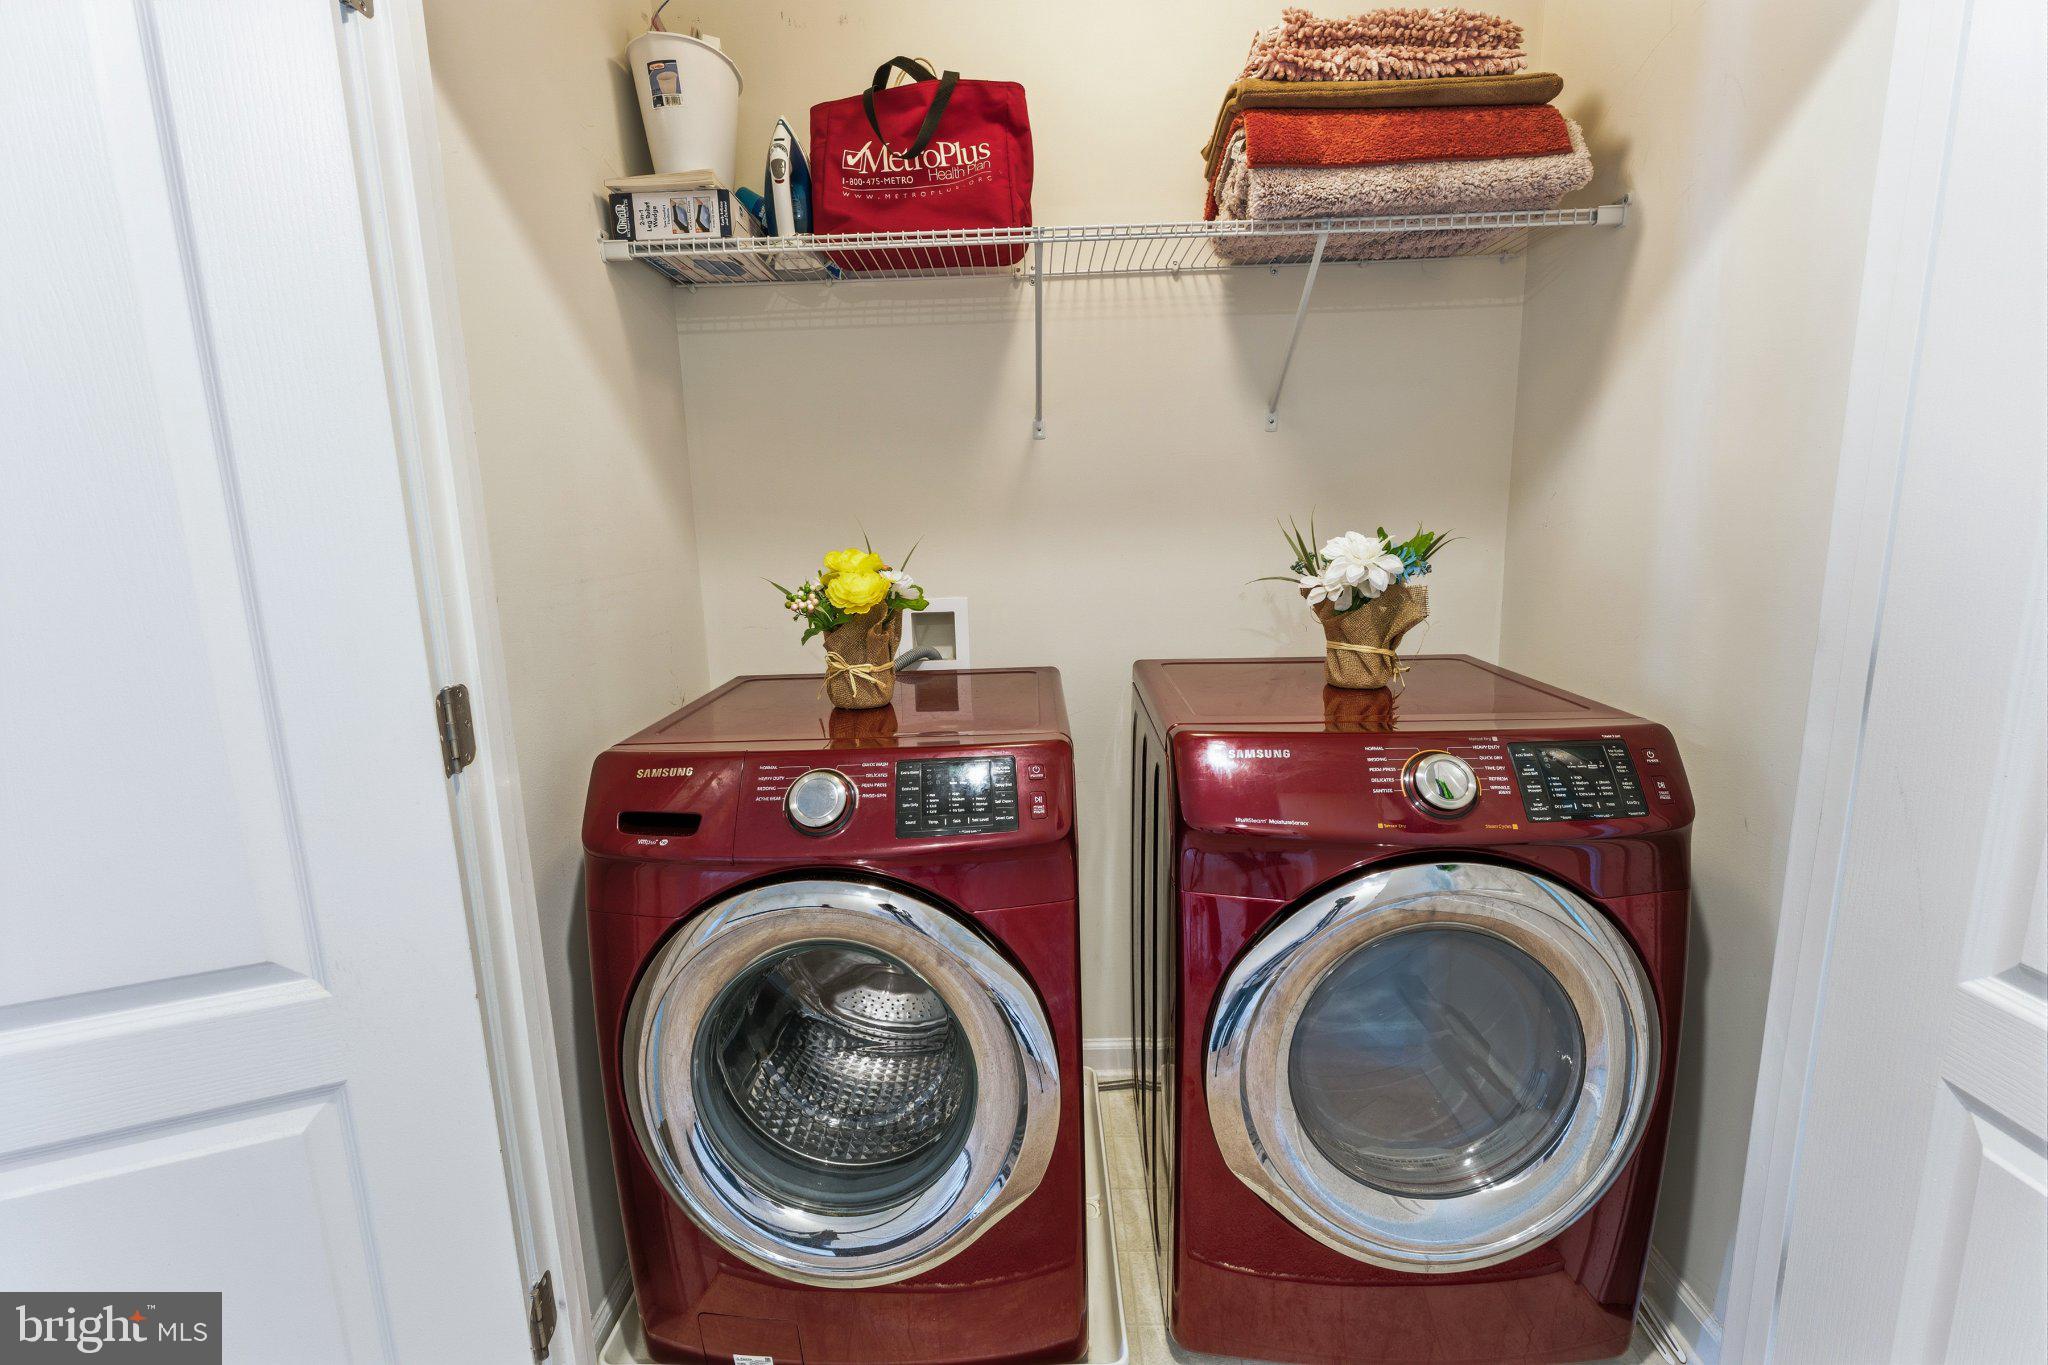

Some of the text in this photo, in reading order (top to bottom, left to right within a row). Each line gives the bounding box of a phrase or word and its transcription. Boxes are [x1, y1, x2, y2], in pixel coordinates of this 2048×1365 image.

[859, 141, 991, 174] MetroPlus
[927, 160, 991, 181] Health Plan
[842, 176, 914, 186] 1-800-475-METRO
[1228, 749, 1291, 759] SAMSUNG
[636, 766, 694, 779] SAMSUNG
